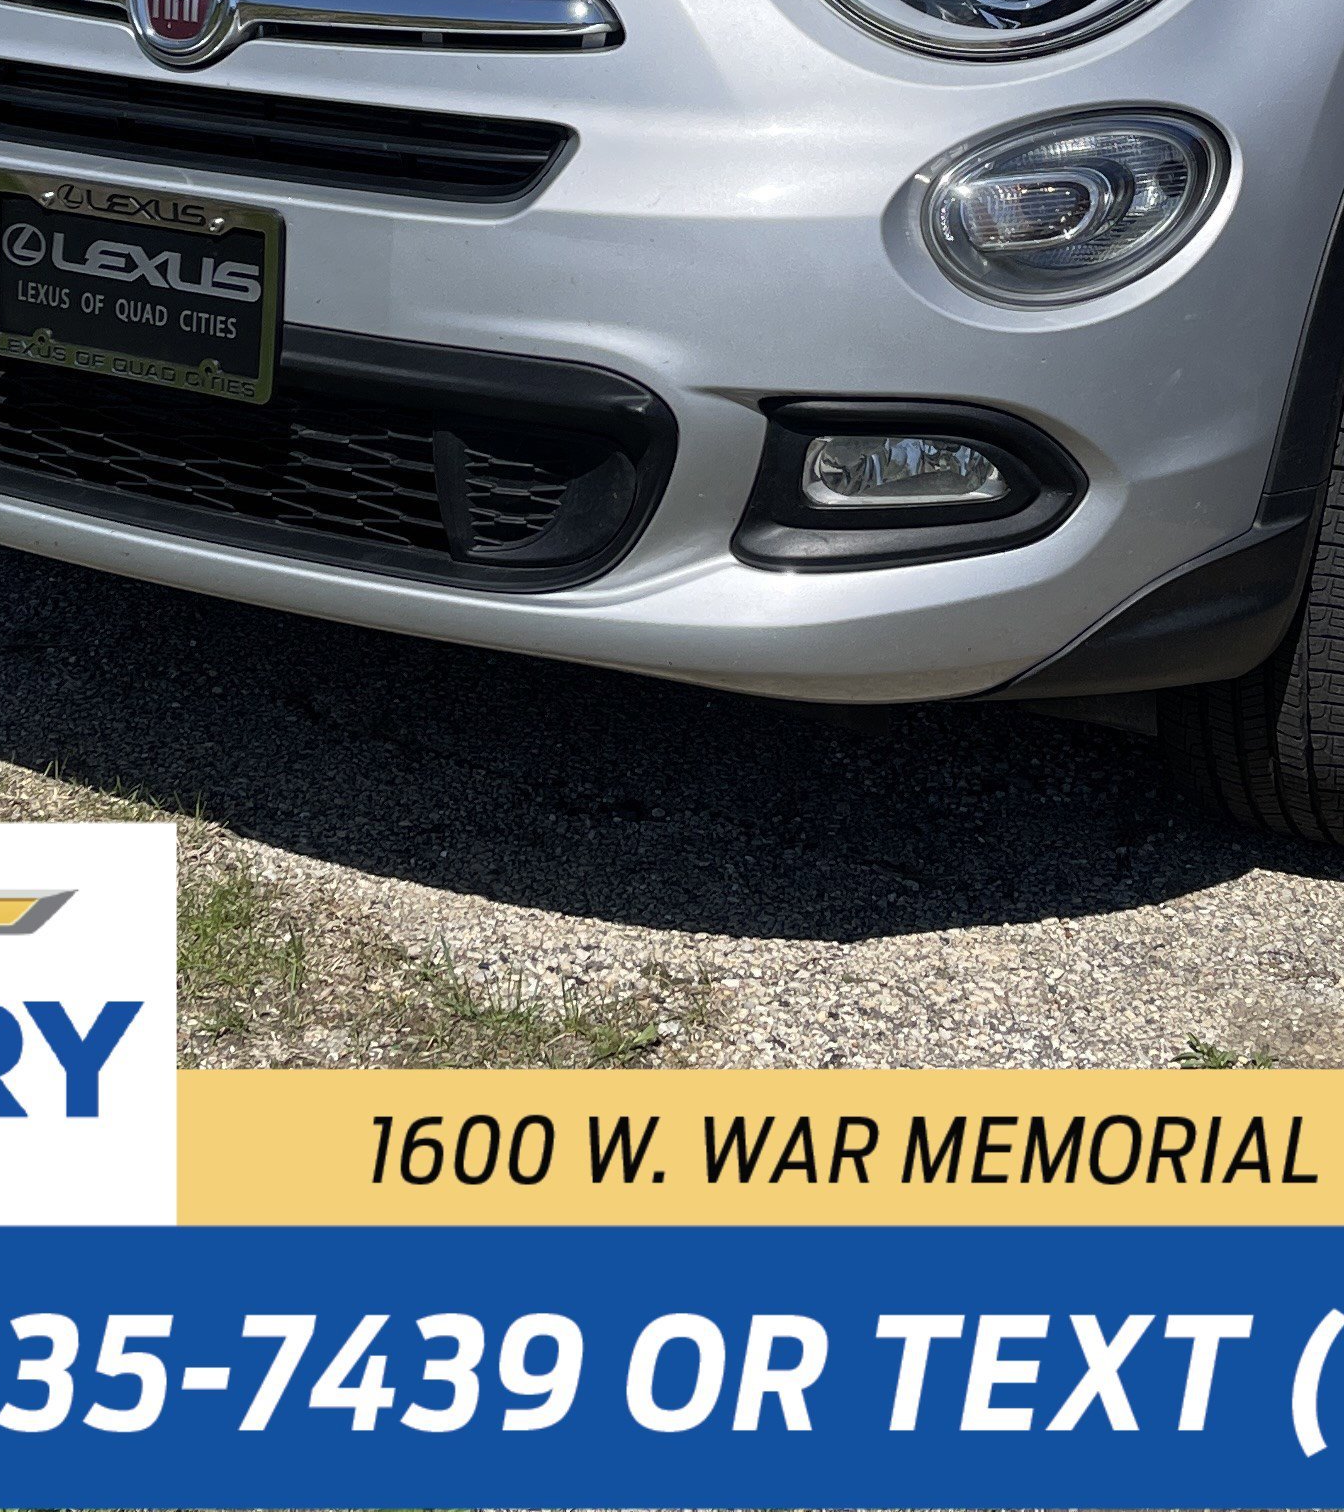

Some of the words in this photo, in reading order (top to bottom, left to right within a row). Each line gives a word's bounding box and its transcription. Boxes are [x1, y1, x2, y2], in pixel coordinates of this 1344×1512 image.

[86, 189, 206, 226] LEXUS
[52, 232, 262, 303] LEXUS
[17, 280, 70, 309] LEXUS
[81, 292, 105, 315] OF
[115, 299, 168, 326] QUAD
[179, 310, 237, 338] CITIES
[76, 350, 105, 367] OF
[113, 358, 176, 382] QUAD
